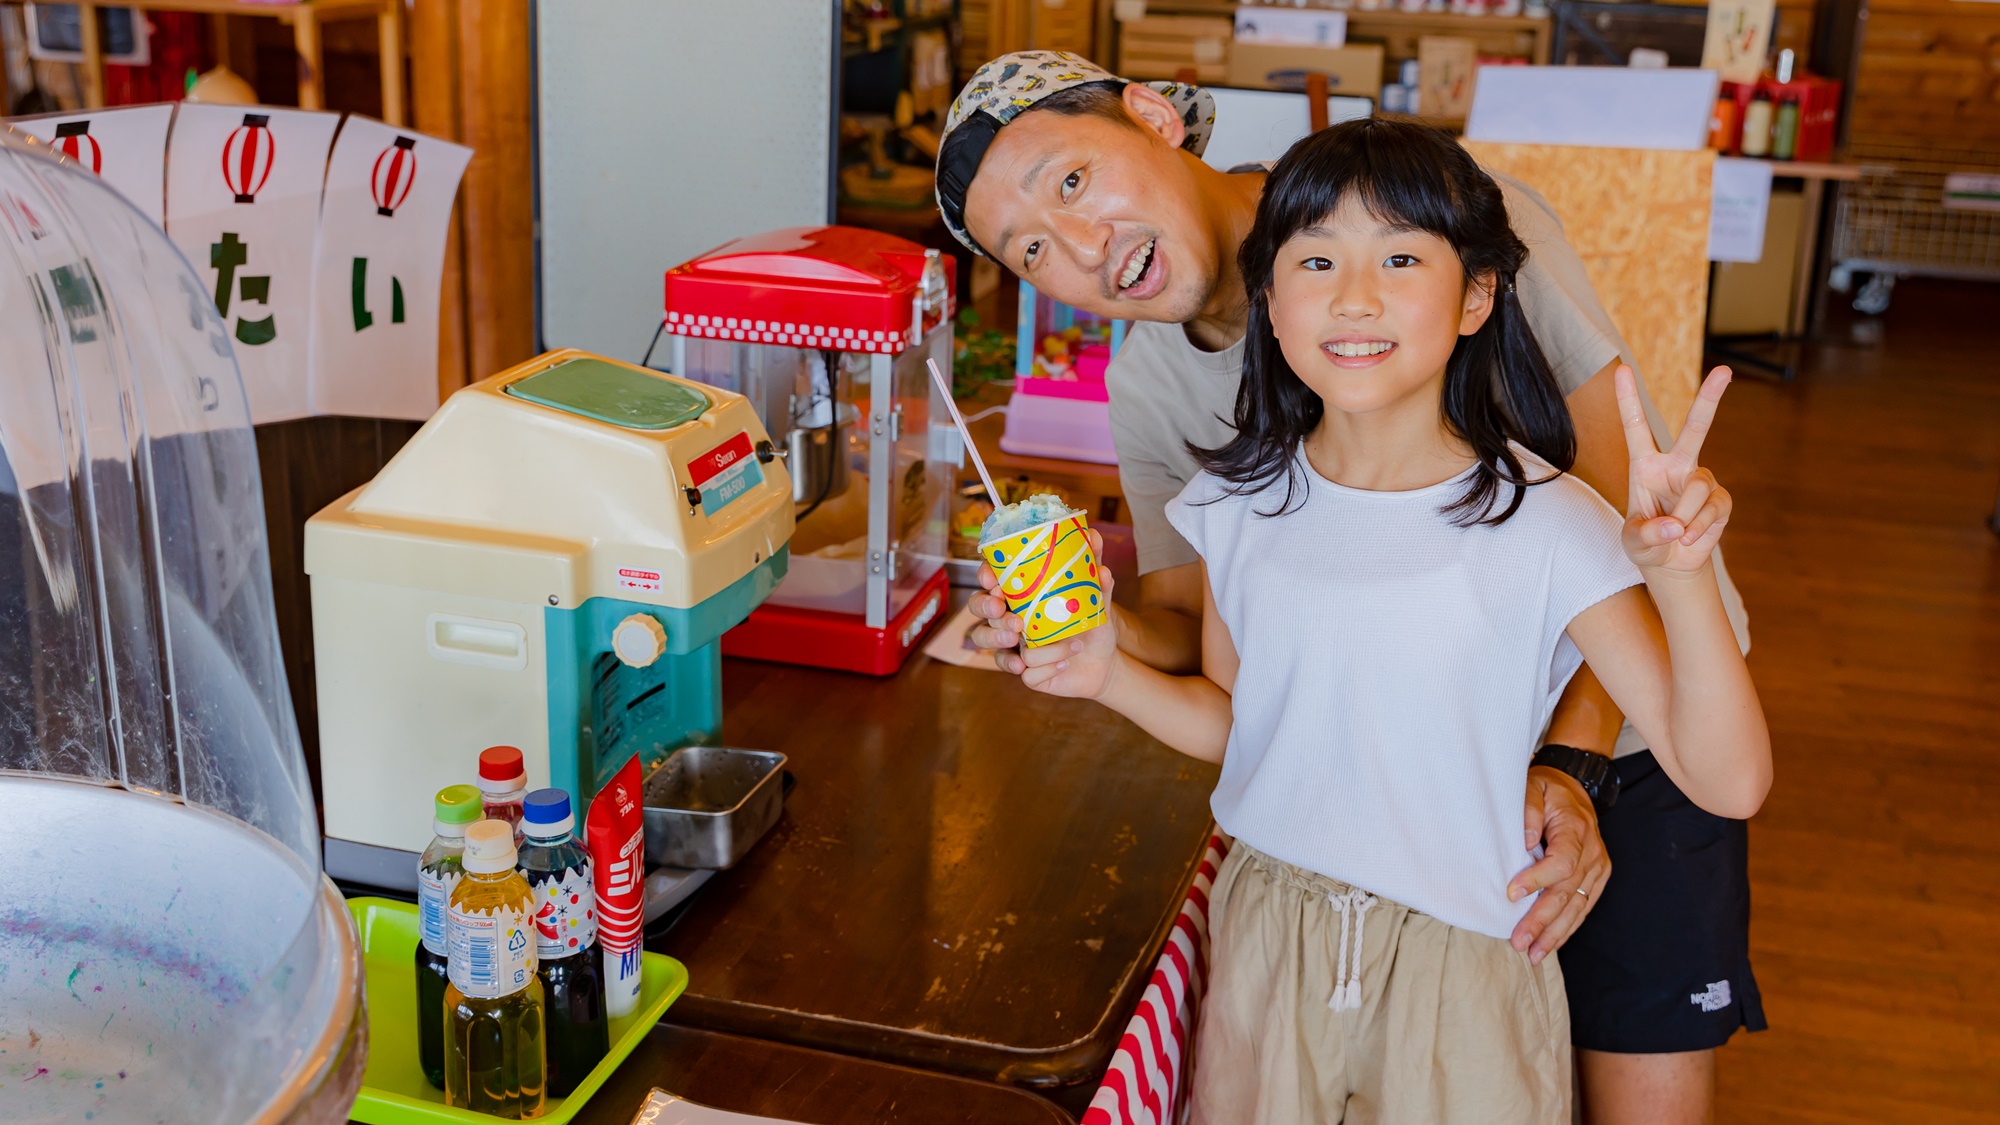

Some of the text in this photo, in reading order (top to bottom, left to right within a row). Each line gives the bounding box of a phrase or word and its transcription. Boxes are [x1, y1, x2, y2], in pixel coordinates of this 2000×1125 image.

[719, 476, 746, 503] FM-500
[607, 849, 644, 897] ミル
[560, 917, 569, 942] 無果汁
